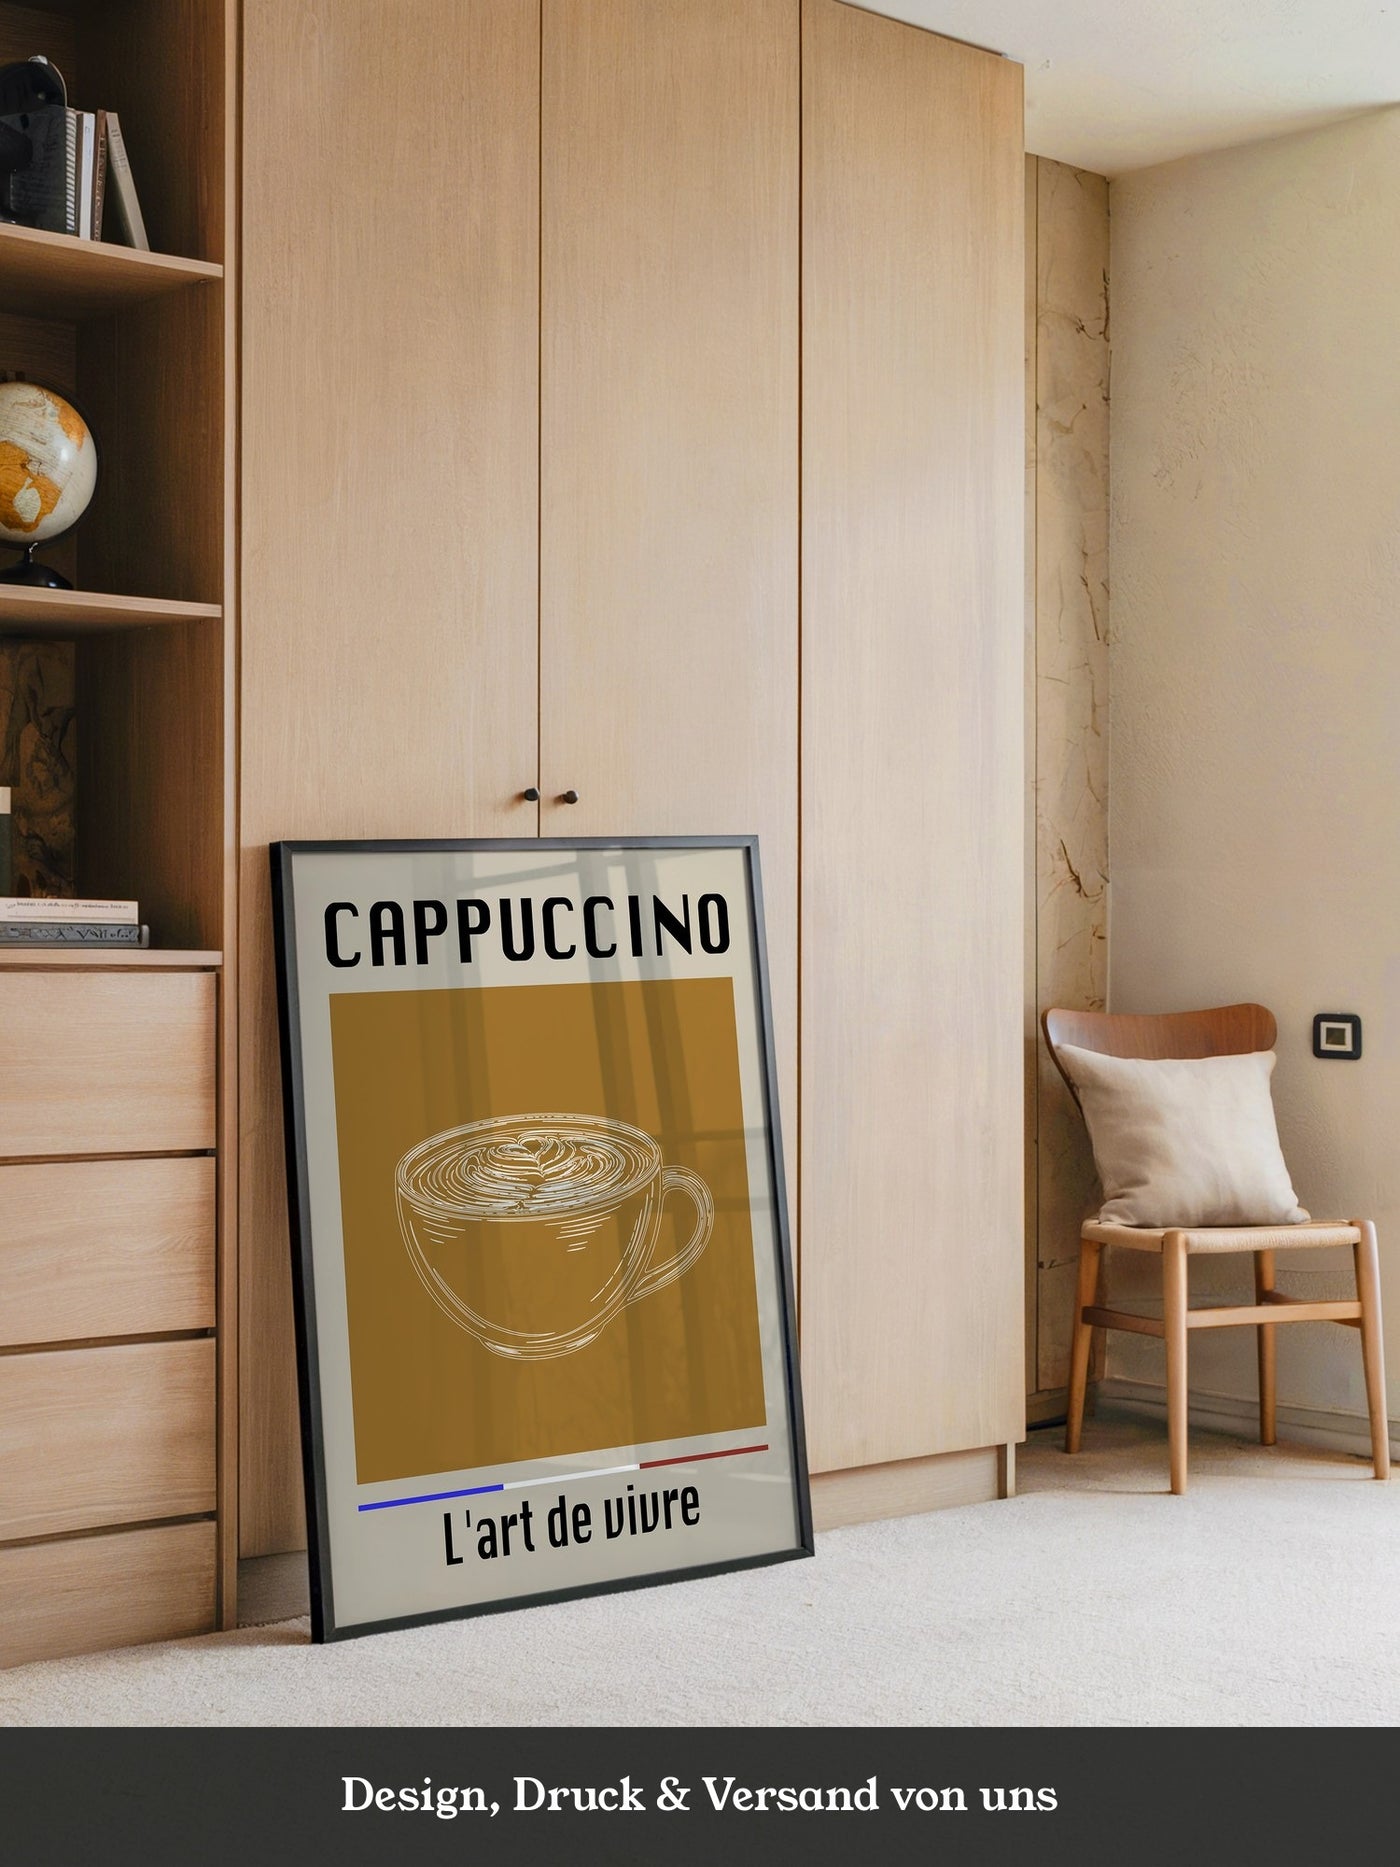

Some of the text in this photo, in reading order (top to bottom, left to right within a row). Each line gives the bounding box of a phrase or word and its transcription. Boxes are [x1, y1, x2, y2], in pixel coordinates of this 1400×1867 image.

[324, 893, 730, 968] CAPPUCCINO
[443, 1484, 700, 1566] L'art de vivre
